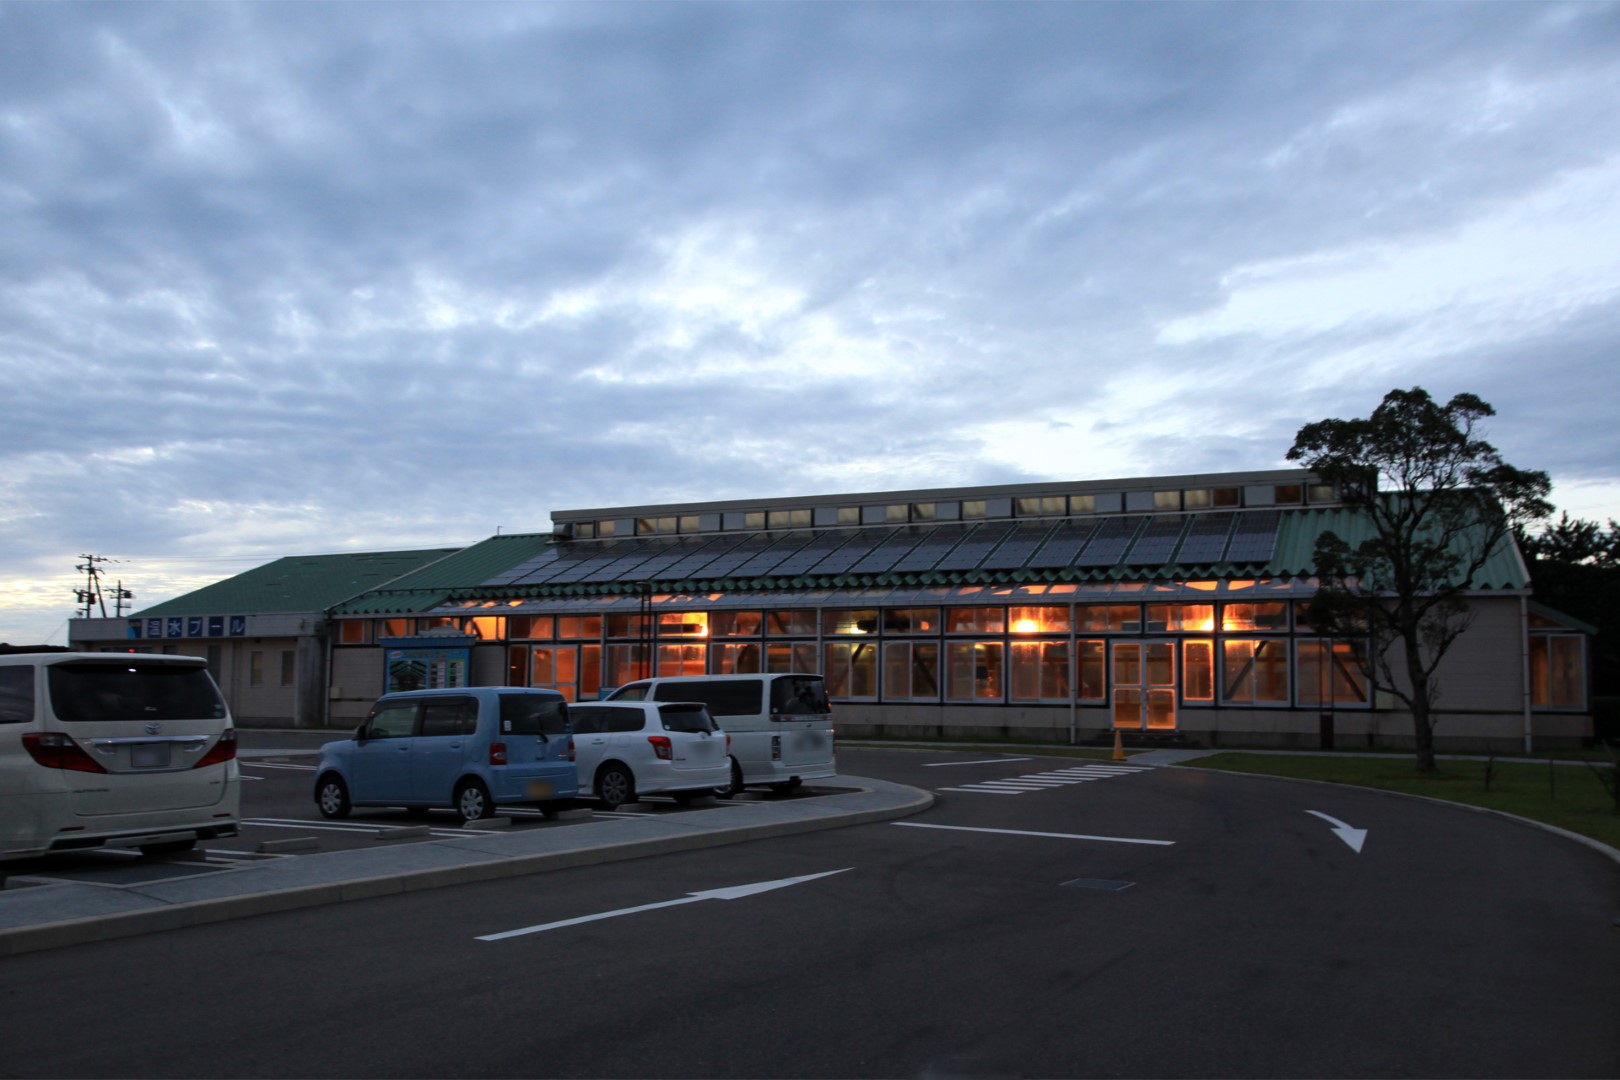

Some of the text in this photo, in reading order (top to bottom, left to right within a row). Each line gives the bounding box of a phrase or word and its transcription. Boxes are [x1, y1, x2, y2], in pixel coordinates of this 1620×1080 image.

[149, 619, 245, 636] 温水プール
